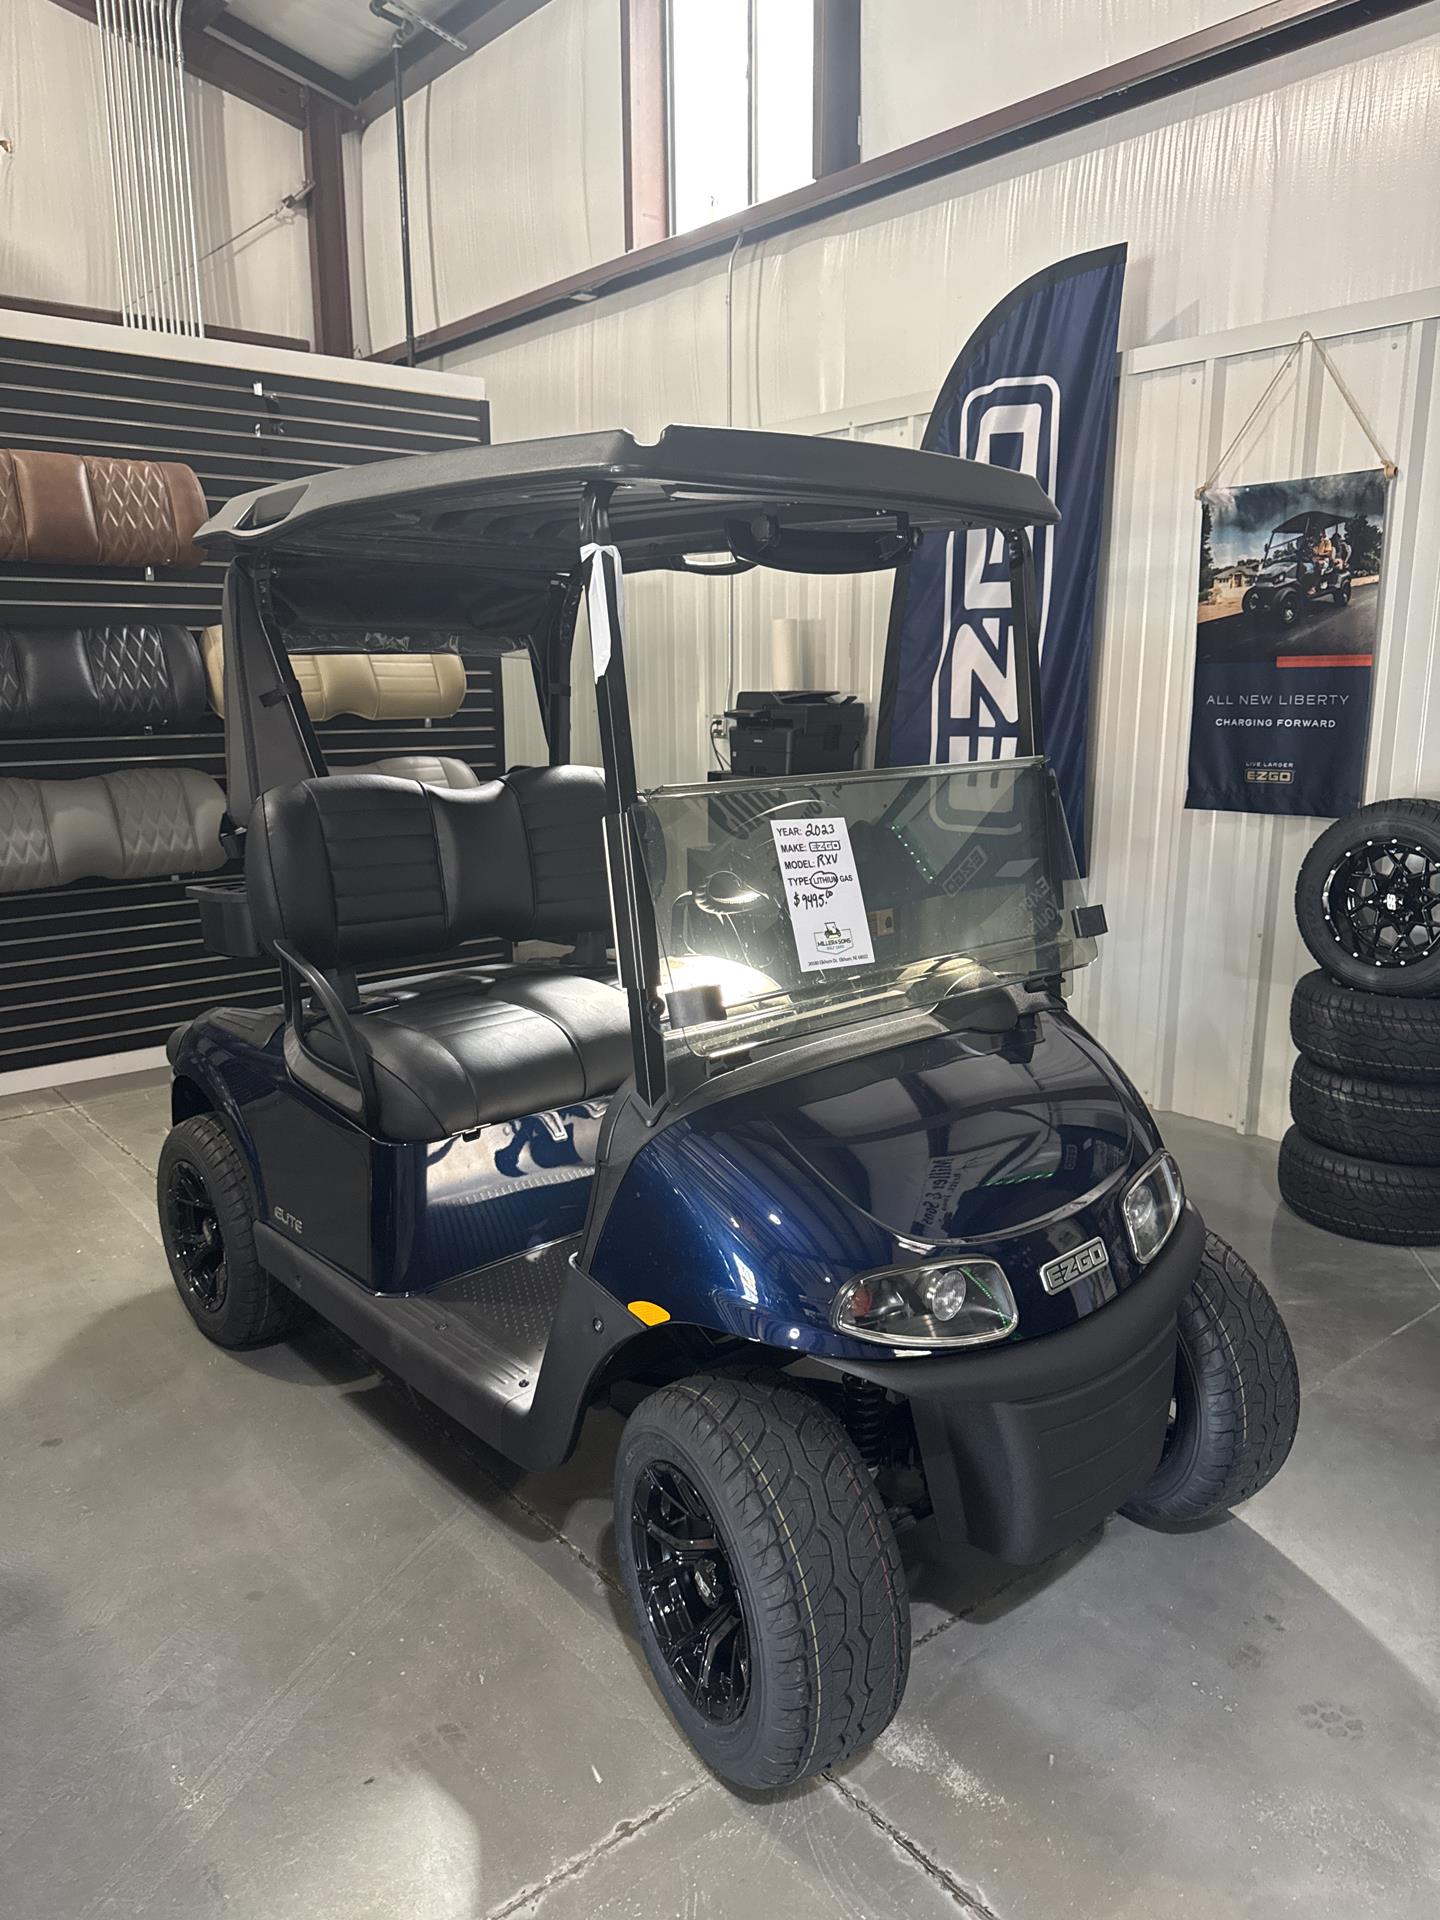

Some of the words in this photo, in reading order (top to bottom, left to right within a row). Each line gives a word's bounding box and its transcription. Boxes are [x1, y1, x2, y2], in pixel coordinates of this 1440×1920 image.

[1206, 694, 1234, 706] ALL
[1239, 694, 1273, 706] NEW
[1278, 694, 1350, 706] LIBERTY
[1215, 718, 1273, 728] CHARGING
[1276, 718, 1336, 729] FORWARD
[1246, 770, 1294, 783] EZGO
[776, 827, 802, 837] YEAR:
[805, 823, 835, 837] 2023
[780, 844, 806, 853] MAKE:
[808, 841, 841, 852] EZGO
[784, 860, 816, 870] MODEL:
[816, 854, 838, 868] RXV
[788, 878, 810, 886] TYPE:
[813, 876, 838, 885] LITHIUM
[274, 1206, 304, 1234] ELITE
[1042, 1239, 1107, 1291] EZGO
